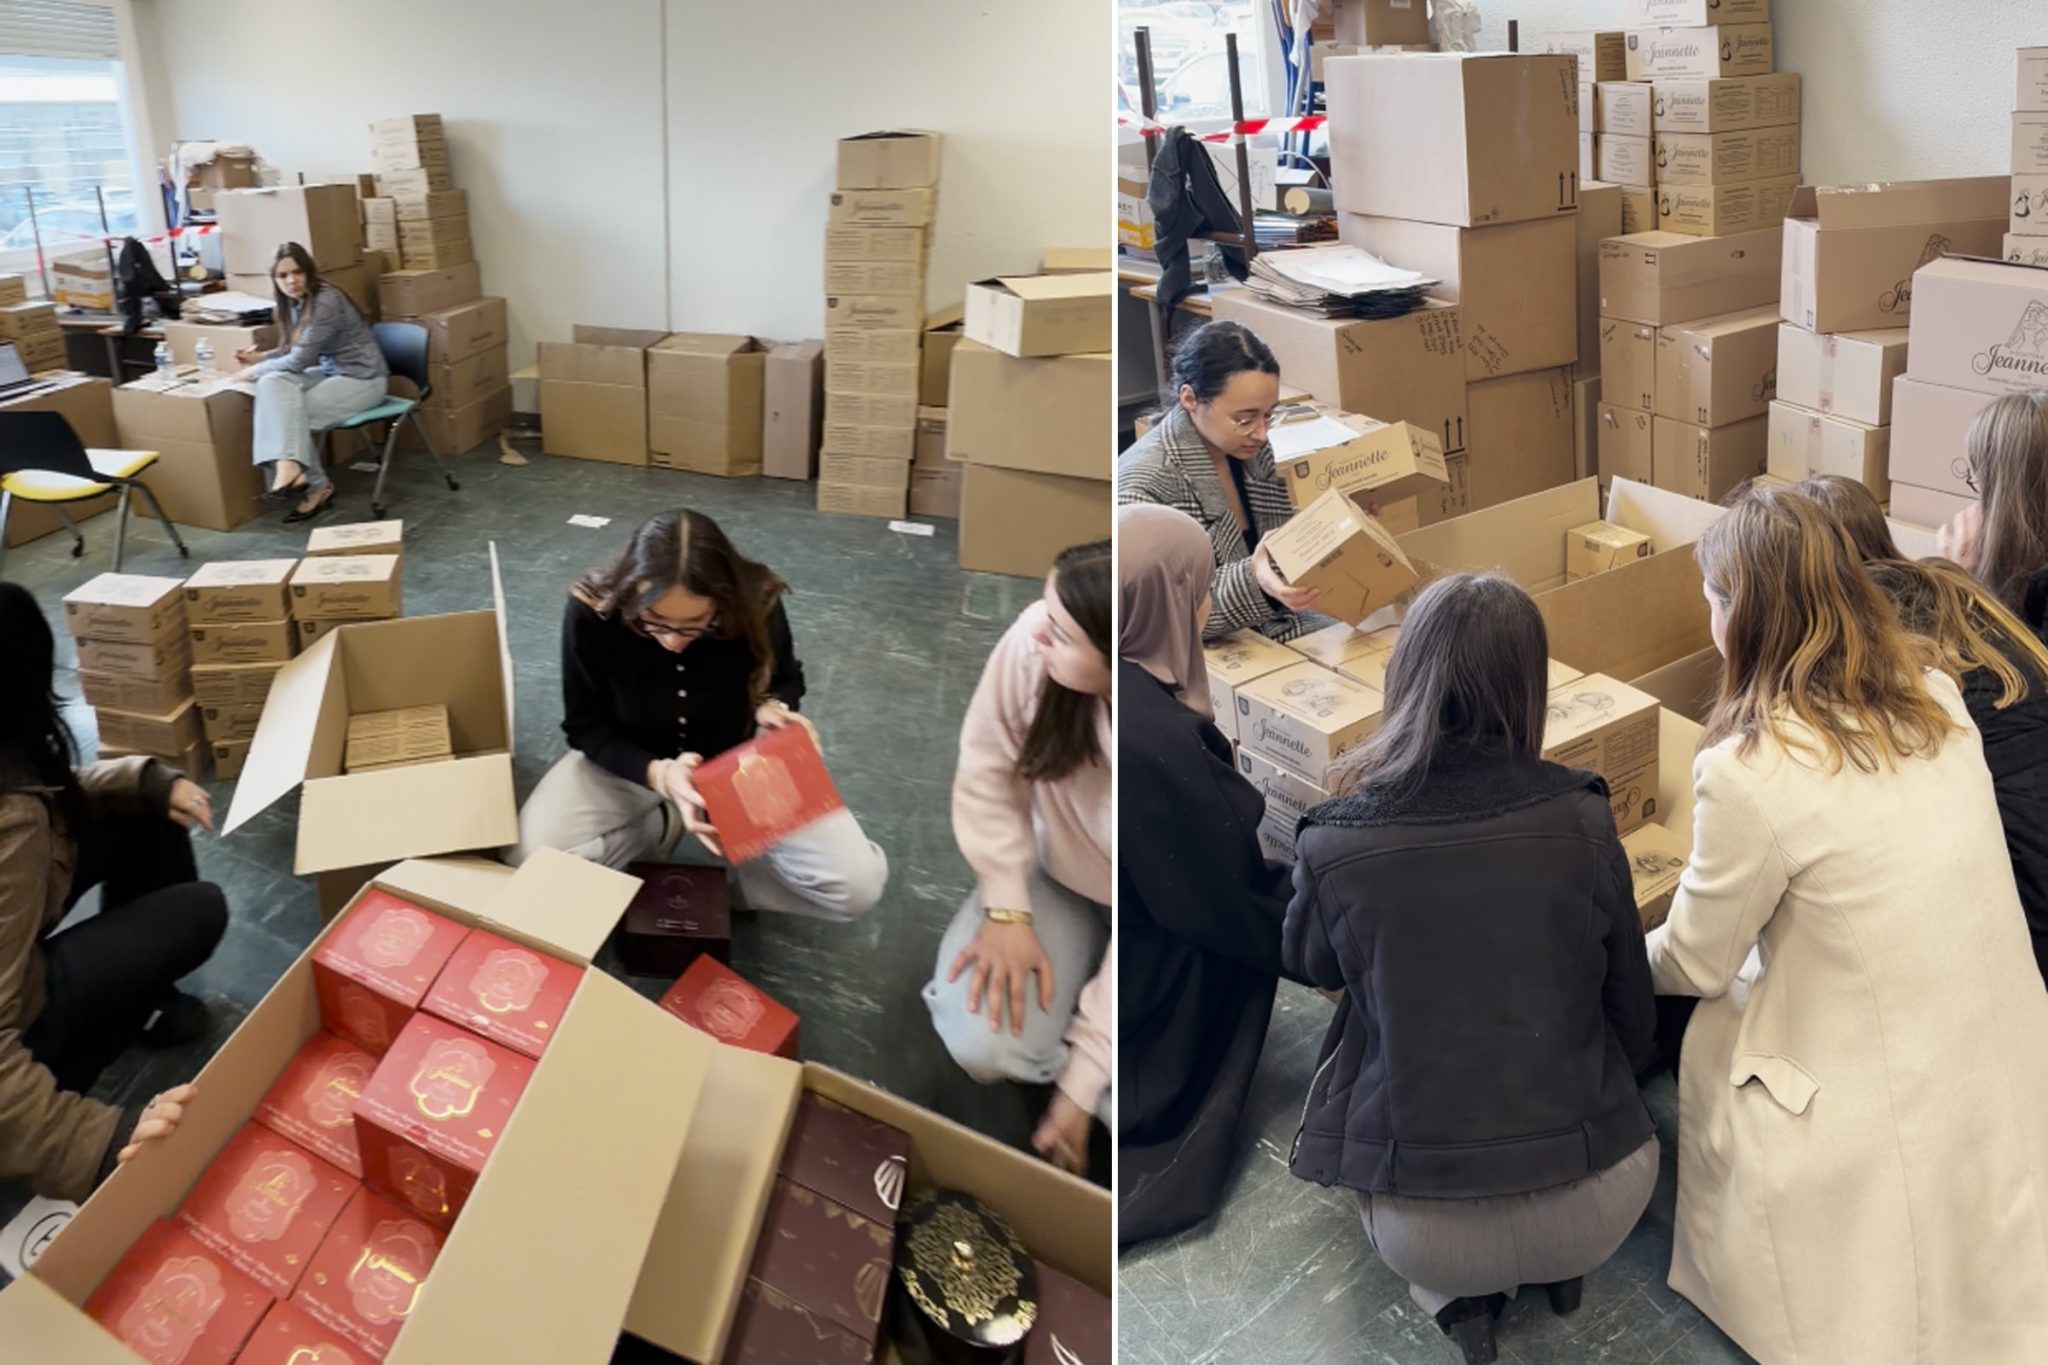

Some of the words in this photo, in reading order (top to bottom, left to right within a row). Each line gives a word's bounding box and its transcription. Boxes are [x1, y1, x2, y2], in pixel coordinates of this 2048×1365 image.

[1642, 41, 1700, 67] Jeannette
[1315, 450, 1390, 491] Jeannette
[1253, 718, 1313, 758] Jeannette
[1254, 776, 1307, 813] Jeannett
